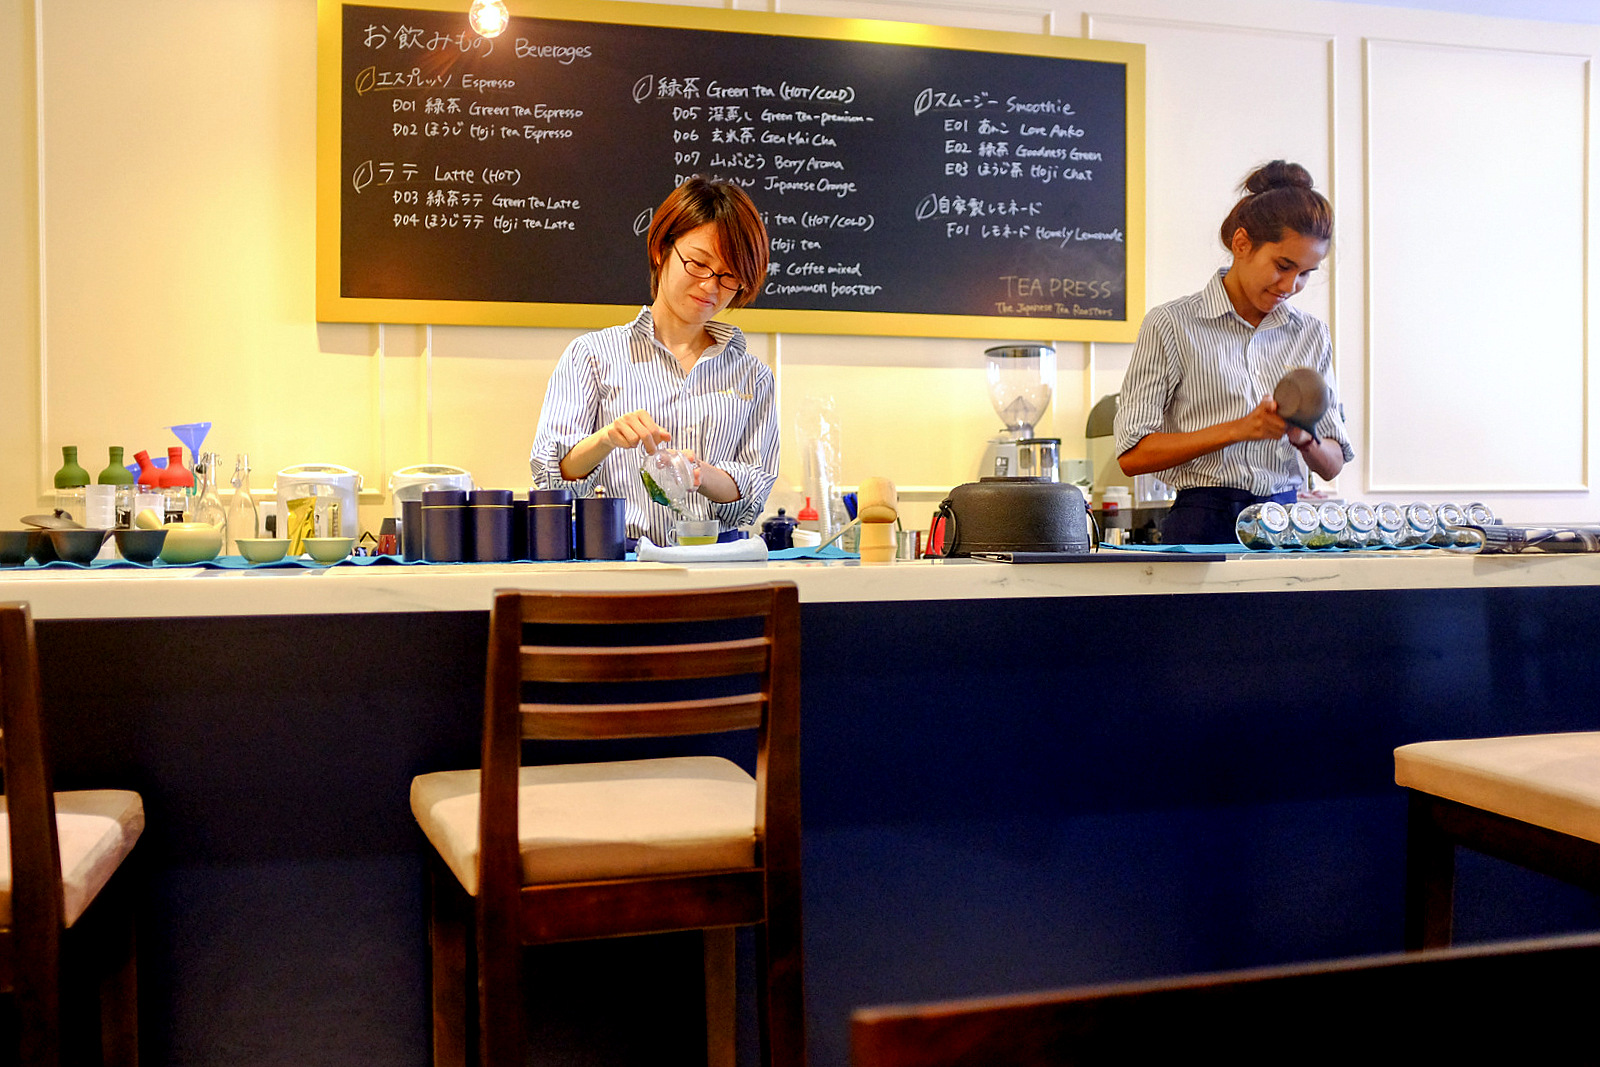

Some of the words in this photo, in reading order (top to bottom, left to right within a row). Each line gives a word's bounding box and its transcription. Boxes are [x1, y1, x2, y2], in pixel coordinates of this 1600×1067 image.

[364, 24, 493, 57] お飲みもの
[515, 38, 592, 64] Beverages
[377, 67, 452, 87] エスプレッソ
[462, 74, 515, 95] Espresso
[658, 77, 700, 99] 緑茶
[706, 81, 749, 98] Green
[752, 85, 776, 98] tea
[424, 97, 461, 114] 緑茶
[469, 101, 509, 117] Green
[534, 104, 583, 123] Espresso
[934, 91, 998, 109] スムージー
[1006, 96, 1075, 115] Smoothie
[672, 107, 701, 121] D05
[761, 109, 793, 123] Green
[393, 123, 418, 136] D02
[425, 121, 463, 136] ほうじ
[470, 124, 495, 140] Hoji
[524, 125, 573, 143] Espresso
[674, 129, 699, 144] D06
[711, 127, 755, 144] 玄米茶
[944, 119, 968, 132] E01
[1050, 124, 1085, 138] Anko
[945, 140, 972, 153] E02
[978, 141, 1009, 157] 緑茶
[1015, 145, 1067, 160] Goodness
[1070, 149, 1102, 161] Green
[379, 162, 419, 183] ラテ
[435, 166, 474, 184] Latte
[675, 152, 700, 166] D07
[710, 153, 766, 169] 山ぶどう
[774, 156, 806, 174] Berry
[807, 157, 844, 171] Aroma
[945, 162, 968, 176] E03
[978, 162, 1024, 177] ほうじ茶
[1030, 164, 1059, 183] Hoji
[765, 176, 814, 195] Japanese
[817, 179, 857, 197] Orange
[393, 190, 418, 205] D03
[426, 190, 483, 207] 緑茶ラテ
[492, 193, 525, 208] Green
[547, 197, 581, 210] Latte
[393, 214, 419, 227] D04
[425, 213, 484, 229] ほうじラテ
[493, 216, 518, 233] Hoji
[544, 218, 575, 230] Latte
[775, 214, 796, 225] tea
[771, 238, 795, 253] Hoji
[801, 240, 821, 250] tea
[946, 222, 969, 238] F01
[982, 224, 1031, 239] レモネード
[1036, 226, 1074, 249] Homely
[1075, 228, 1123, 242] Lemonade
[786, 262, 825, 275] Coffee
[827, 262, 862, 276] mixed
[831, 281, 882, 298] booster
[999, 275, 1044, 298] TEA
[1049, 278, 1112, 299] PRESS
[995, 302, 1014, 314] The
[1016, 303, 1053, 316] Japanese
